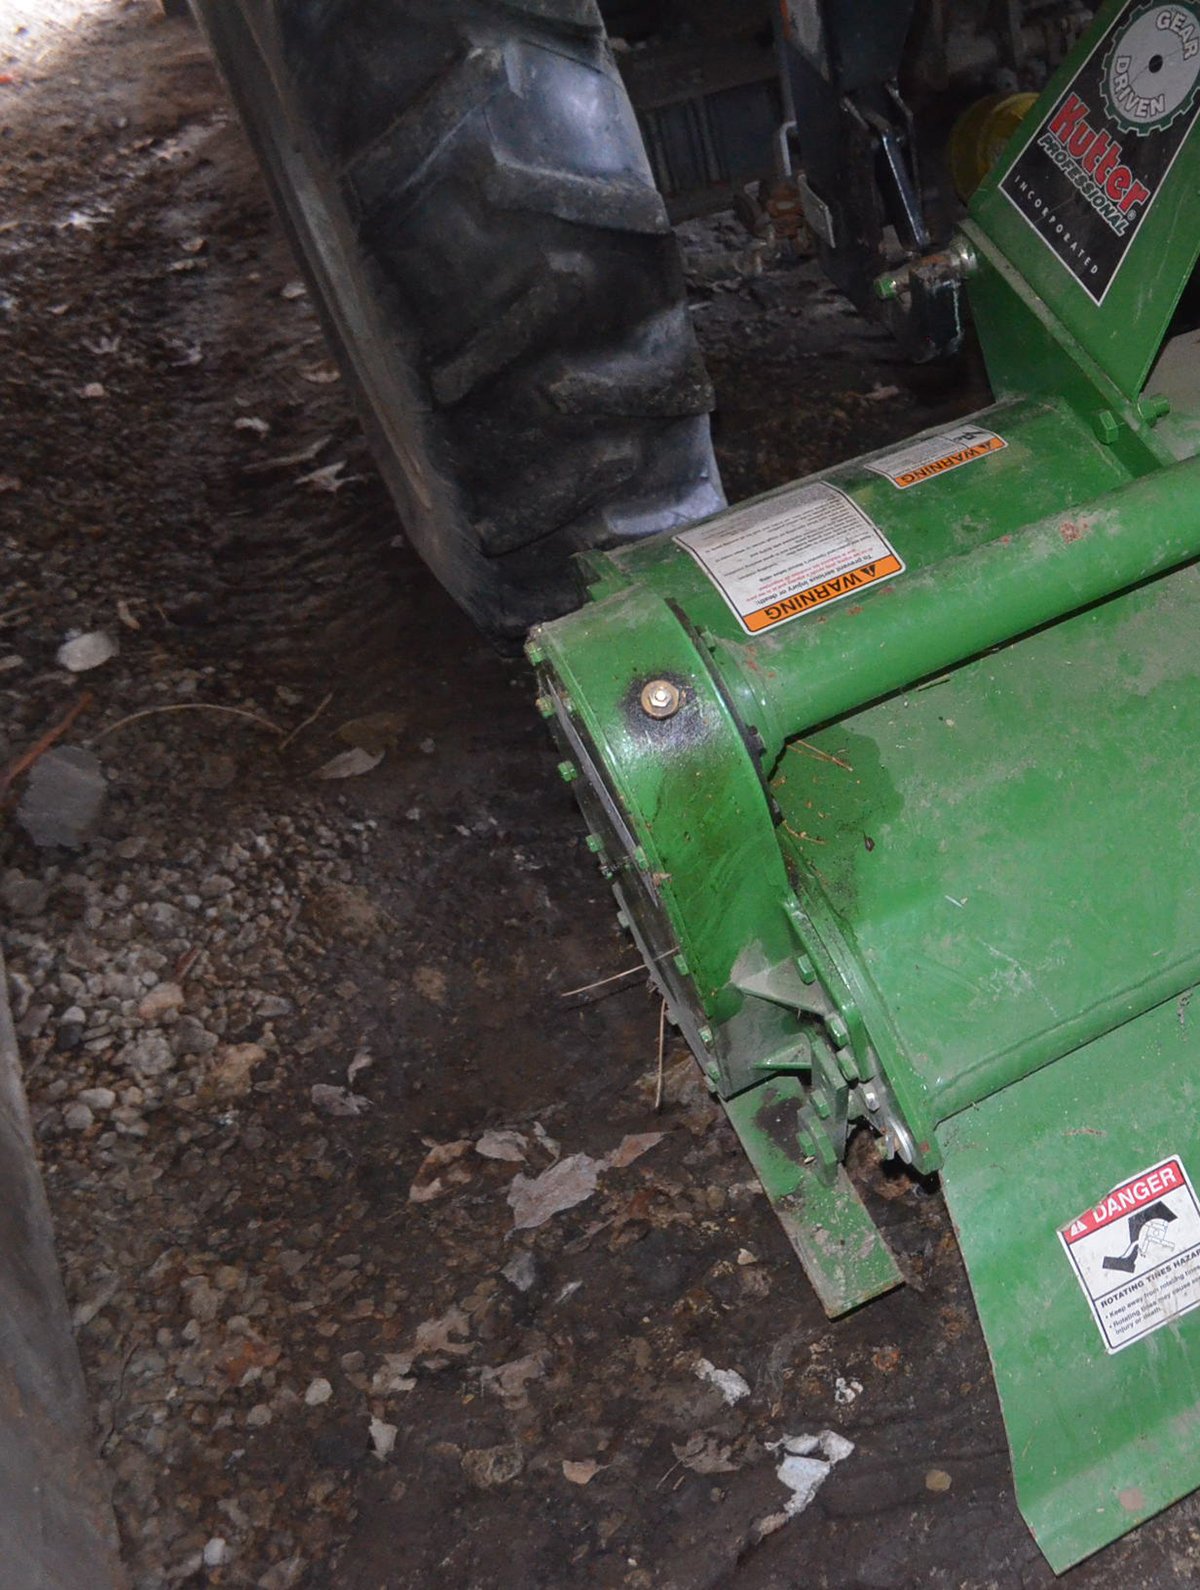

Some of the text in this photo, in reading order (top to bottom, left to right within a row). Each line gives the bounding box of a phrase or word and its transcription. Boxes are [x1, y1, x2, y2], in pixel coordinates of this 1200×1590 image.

[1155, 9, 1199, 61] GEAR
[1113, 55, 1166, 118] DRIVEN
[1048, 92, 1151, 215] Kutter
[1037, 132, 1130, 237] PROFESSIONAL
[1014, 174, 1098, 275] INCORPORATED
[900, 448, 981, 484] WARNING
[785, 579, 809, 592] injury
[808, 569, 836, 583] serious
[834, 557, 863, 572] prevent
[762, 571, 862, 621] WARNING
[1092, 1166, 1178, 1223] DANGER
[1100, 1280, 1144, 1308] ROTATING
[1146, 1264, 1172, 1283] TINES
[1109, 1306, 1127, 1318] Keep
[1127, 1297, 1143, 1309] away
[1144, 1287, 1159, 1299] from
[1160, 1274, 1185, 1290] rotating
[1113, 1309, 1140, 1327] Rotating
[1141, 1300, 1157, 1312] tines
[1158, 1292, 1171, 1303] may
[1172, 1282, 1191, 1295] cause
[1115, 1321, 1135, 1335] injury
[1135, 1316, 1142, 1325] or
